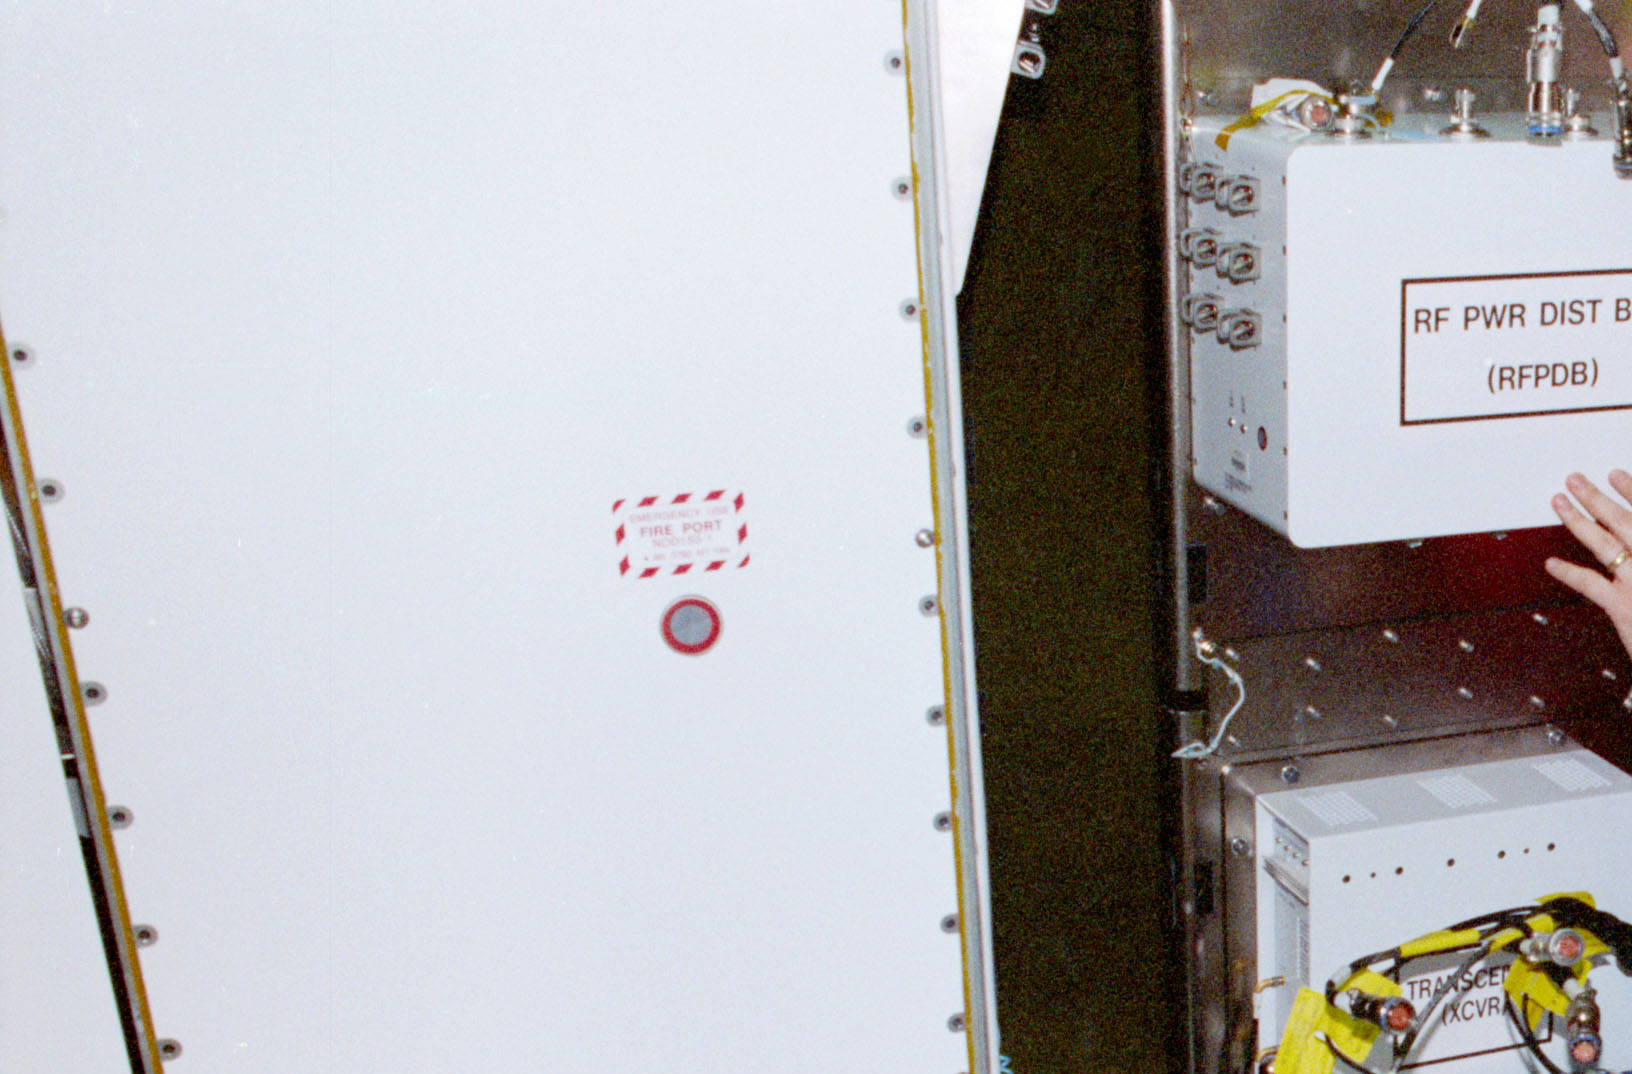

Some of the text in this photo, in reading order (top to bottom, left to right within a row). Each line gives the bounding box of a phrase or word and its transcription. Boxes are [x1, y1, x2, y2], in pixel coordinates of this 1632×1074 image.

[1414, 307, 1450, 333] RF
[1464, 303, 1526, 331] PWR
[1540, 299, 1602, 327] DIST
[1488, 358, 1599, 394] (RFPDB)
[640, 520, 722, 537] FIRE PORT
